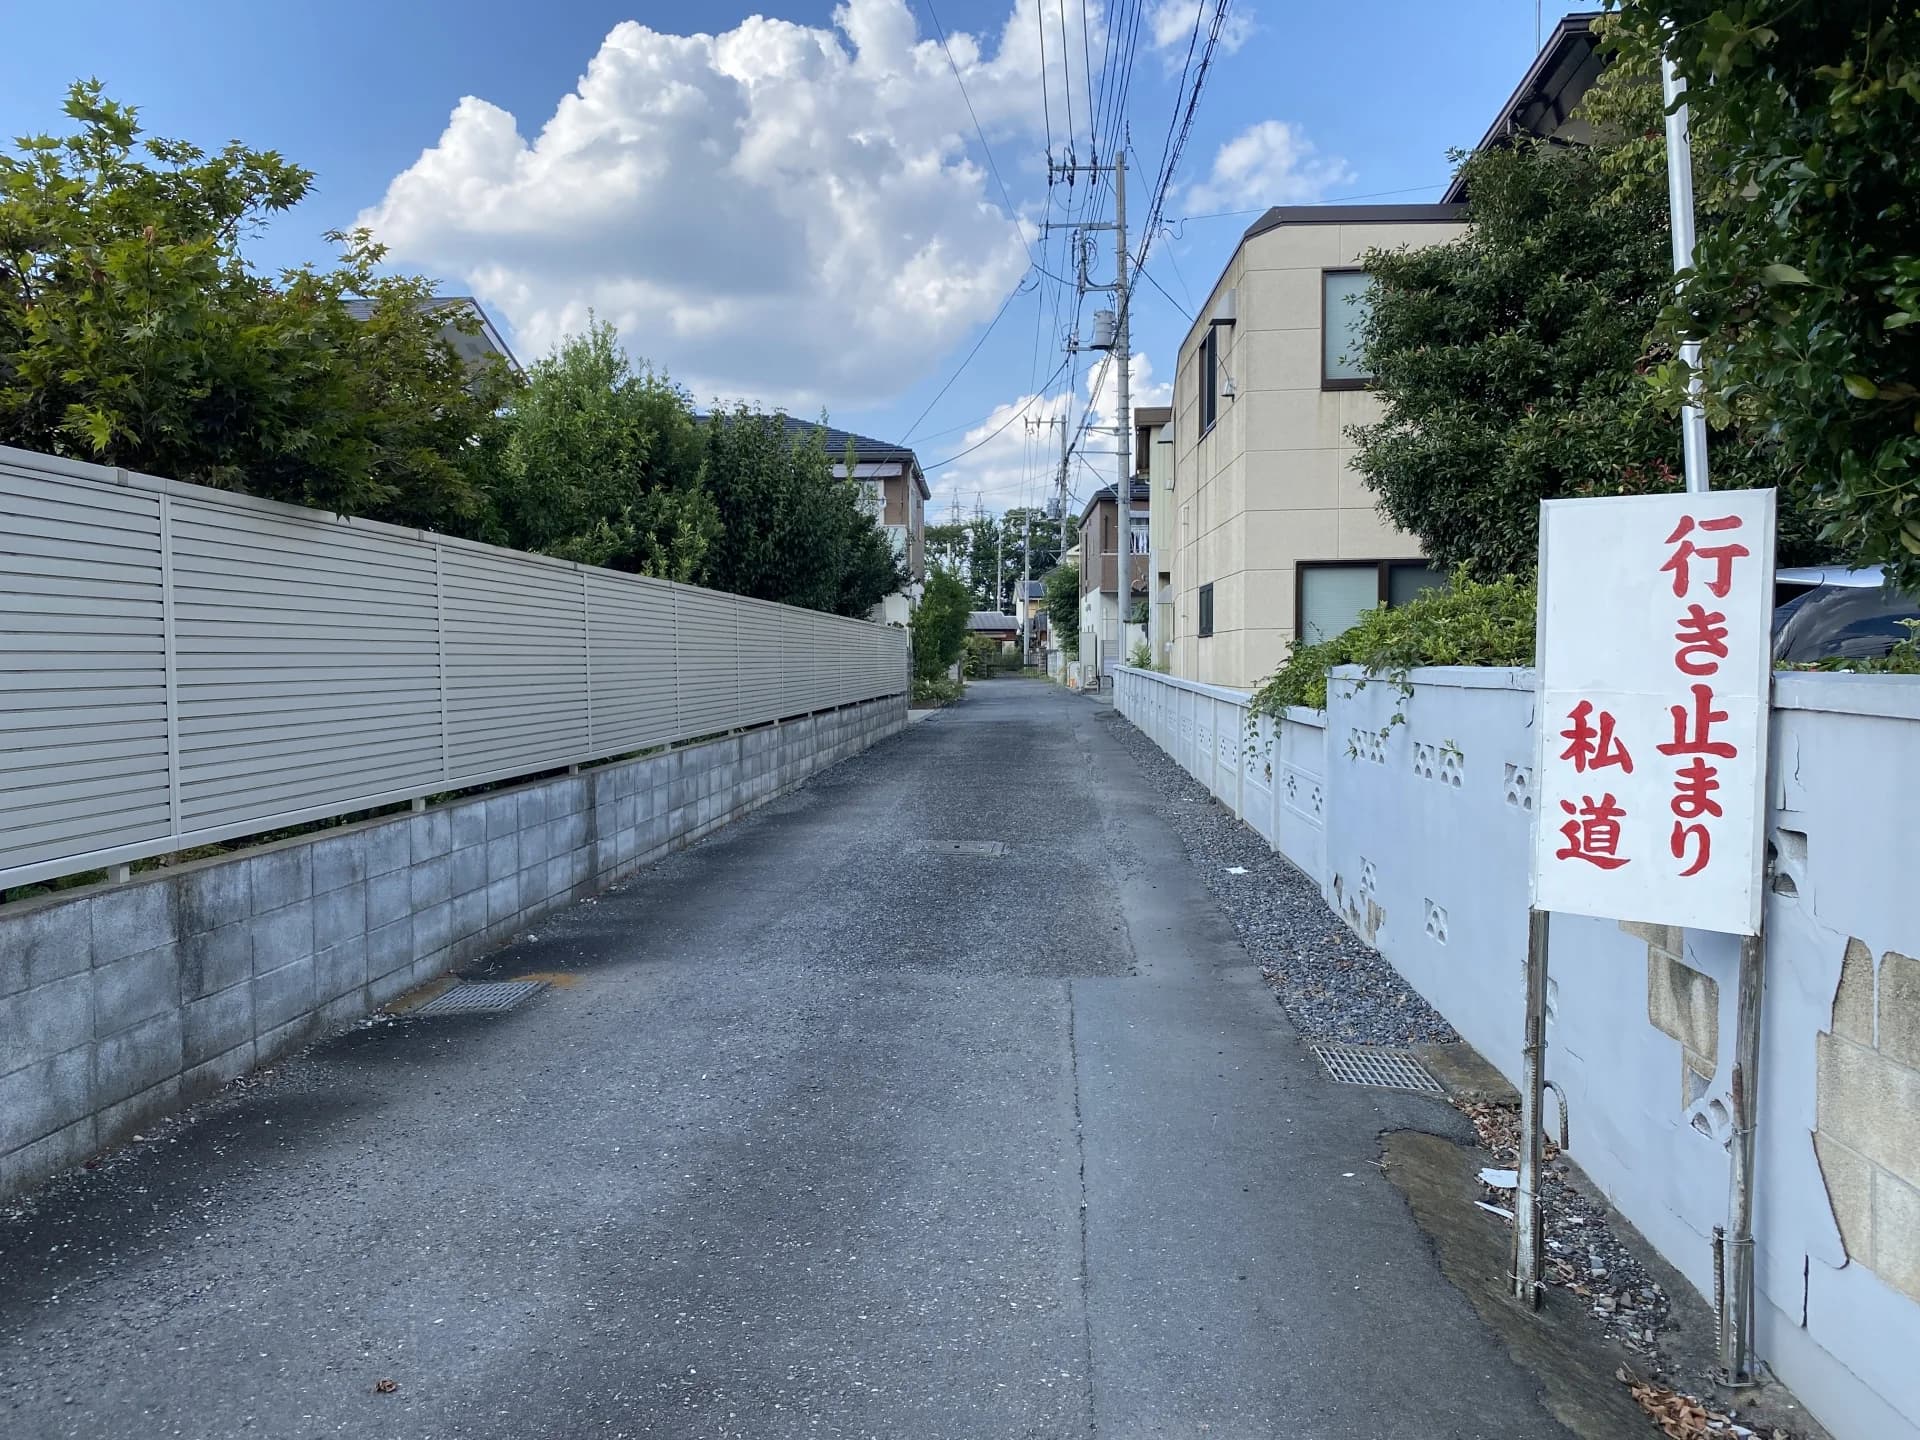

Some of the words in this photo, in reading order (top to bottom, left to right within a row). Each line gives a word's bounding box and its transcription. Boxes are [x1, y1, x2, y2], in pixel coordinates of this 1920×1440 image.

[1555, 700, 1634, 870] 私道
[1656, 515, 1750, 877] 行き止まり
